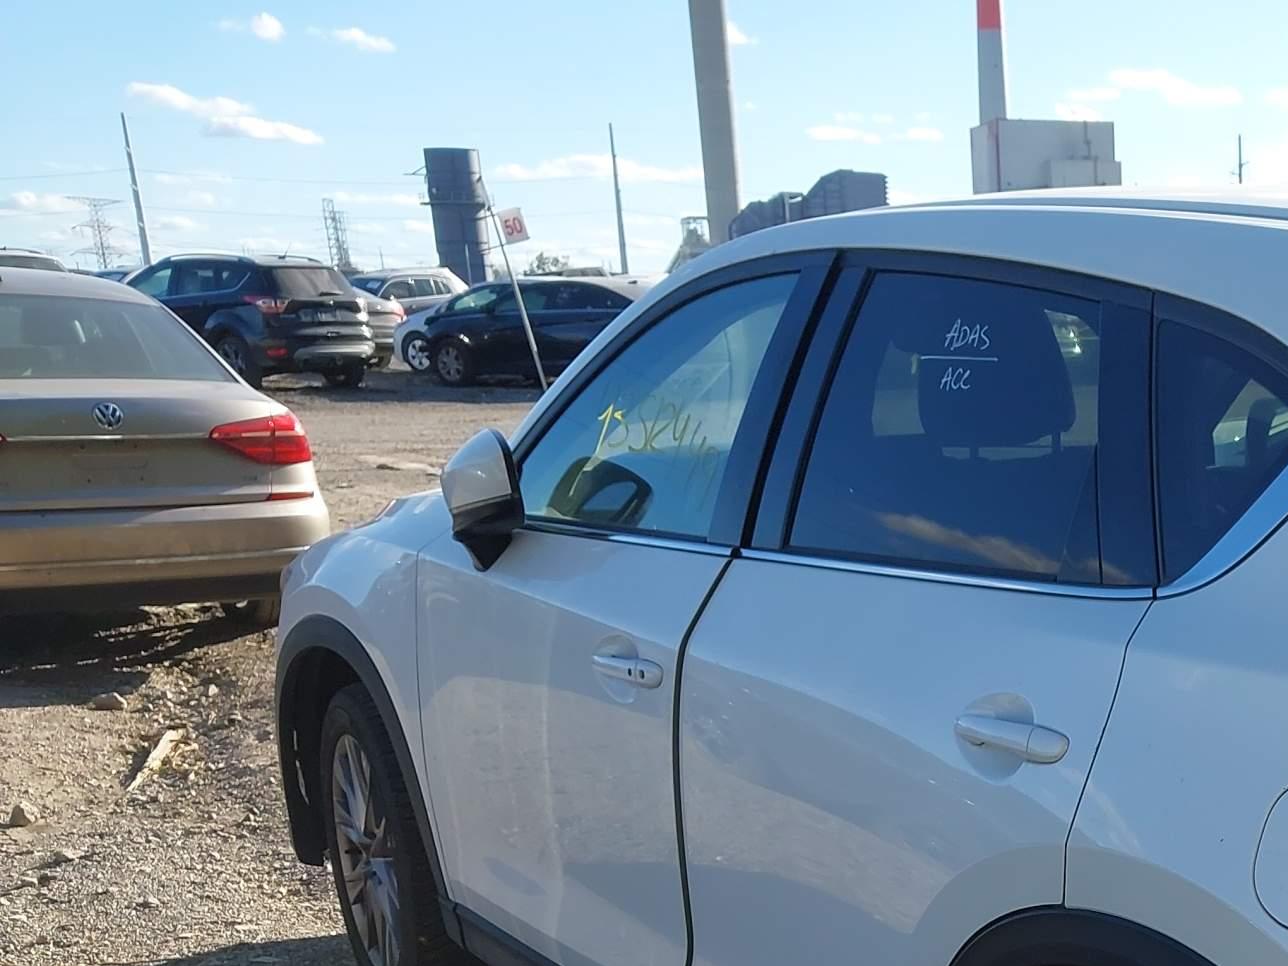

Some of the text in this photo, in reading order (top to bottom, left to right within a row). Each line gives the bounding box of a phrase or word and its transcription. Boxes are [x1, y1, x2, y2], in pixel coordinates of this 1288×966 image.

[503, 216, 523, 236] 50
[944, 318, 990, 351] ADAS
[940, 366, 971, 391] ACC
